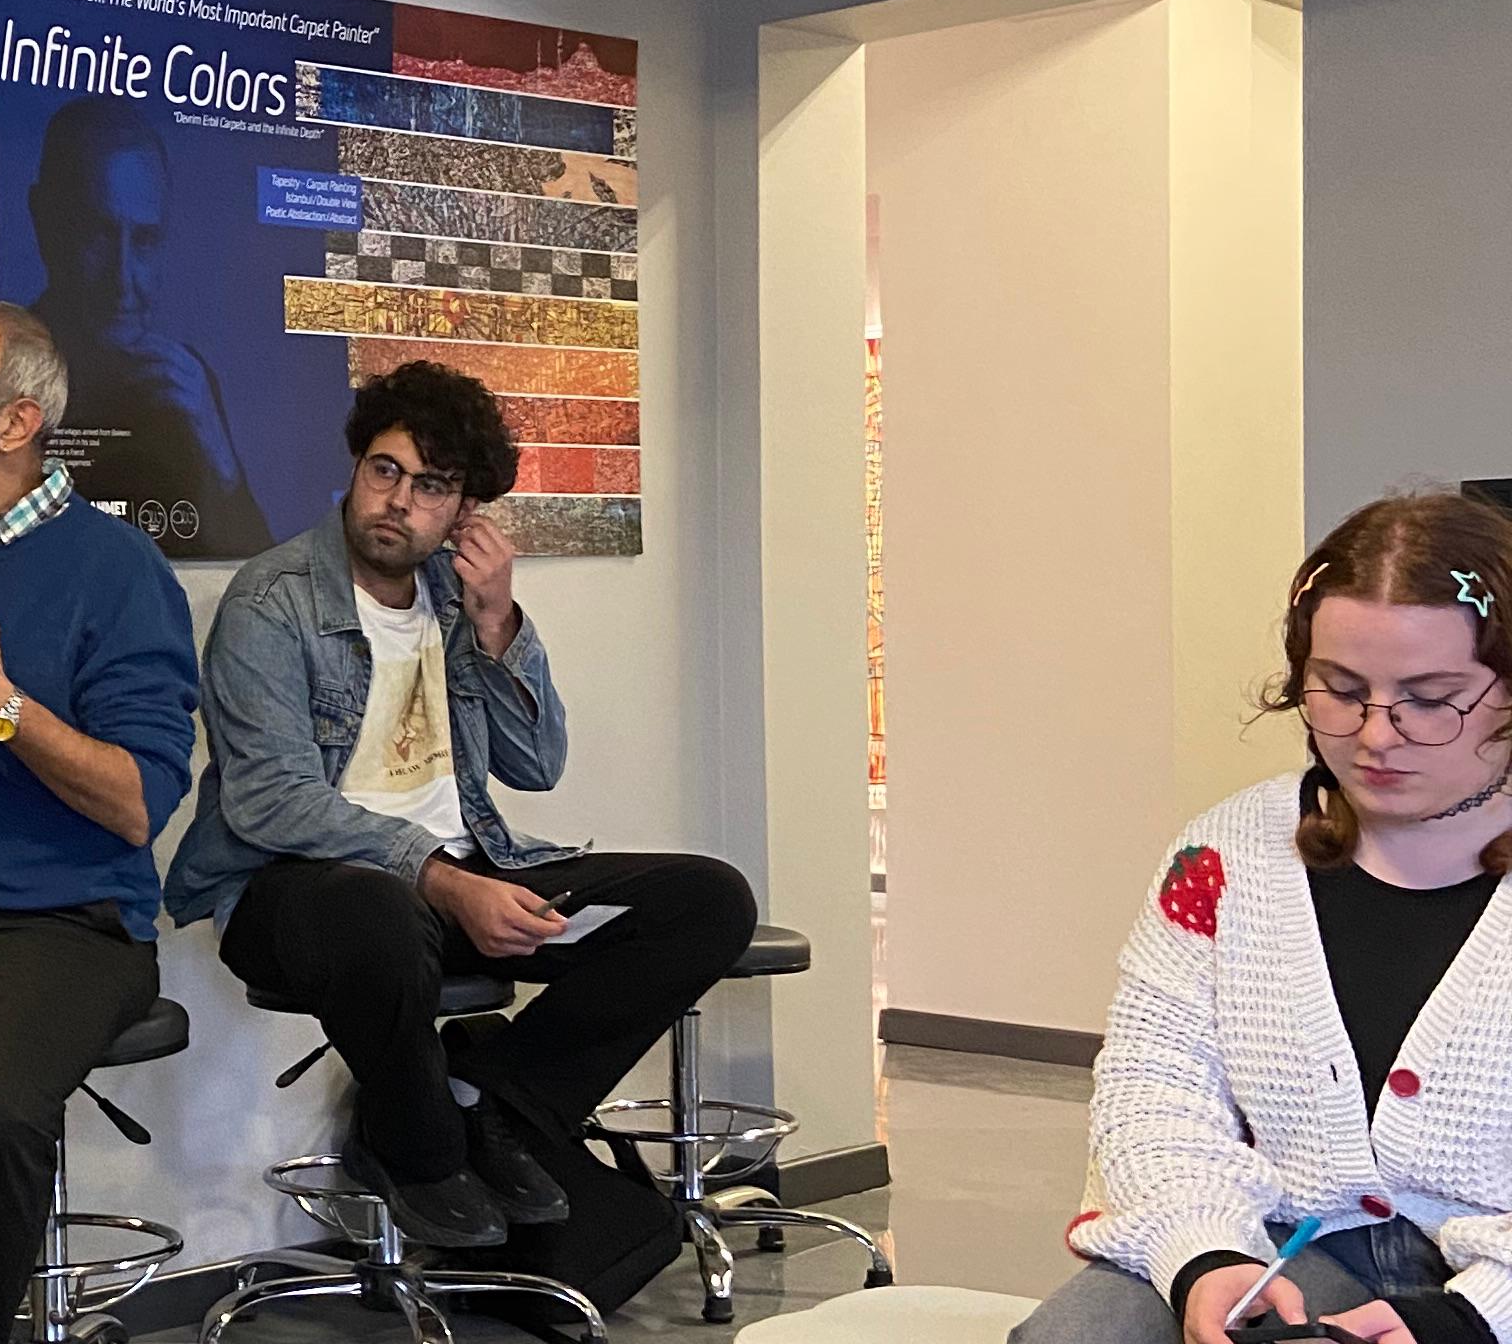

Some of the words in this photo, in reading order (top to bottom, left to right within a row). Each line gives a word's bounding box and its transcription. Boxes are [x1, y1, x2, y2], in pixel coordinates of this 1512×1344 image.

[224, 5, 287, 32] Important
[289, 14, 330, 40] Carpet
[1, 19, 152, 98] Infinite
[163, 44, 288, 116] Colors
[202, 115, 219, 127] Erbil
[220, 117, 247, 131] Carpets
[247, 122, 262, 133] and
[262, 123, 275, 134] the
[275, 124, 299, 136] Infinite
[271, 174, 301, 190] Tapestry
[306, 178, 329, 192] Carpet
[266, 205, 287, 218] Poetic
[341, 198, 358, 209] View
